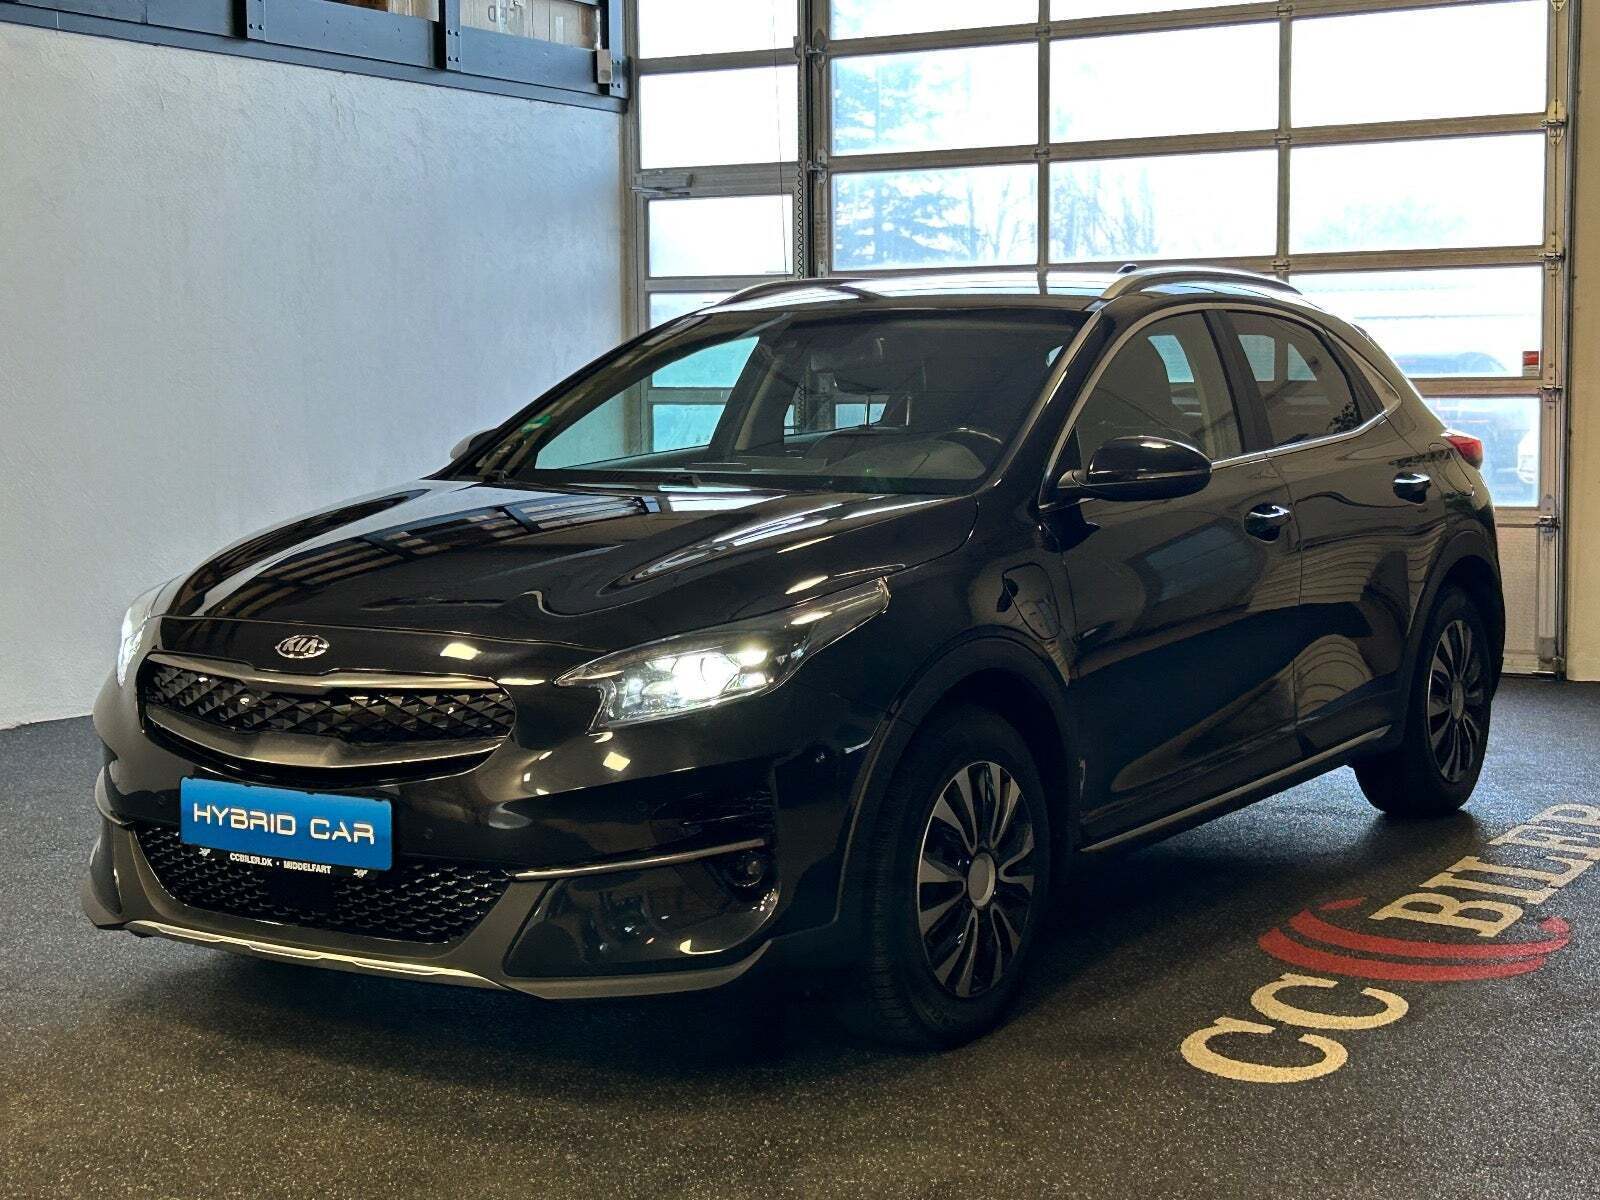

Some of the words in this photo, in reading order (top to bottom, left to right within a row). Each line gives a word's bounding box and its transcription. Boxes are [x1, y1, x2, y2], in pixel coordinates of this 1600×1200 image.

[280, 636, 320, 655] KIA
[193, 803, 297, 836] HYBRID
[310, 817, 375, 845] CAR
[283, 860, 332, 874] MIDDELFART
